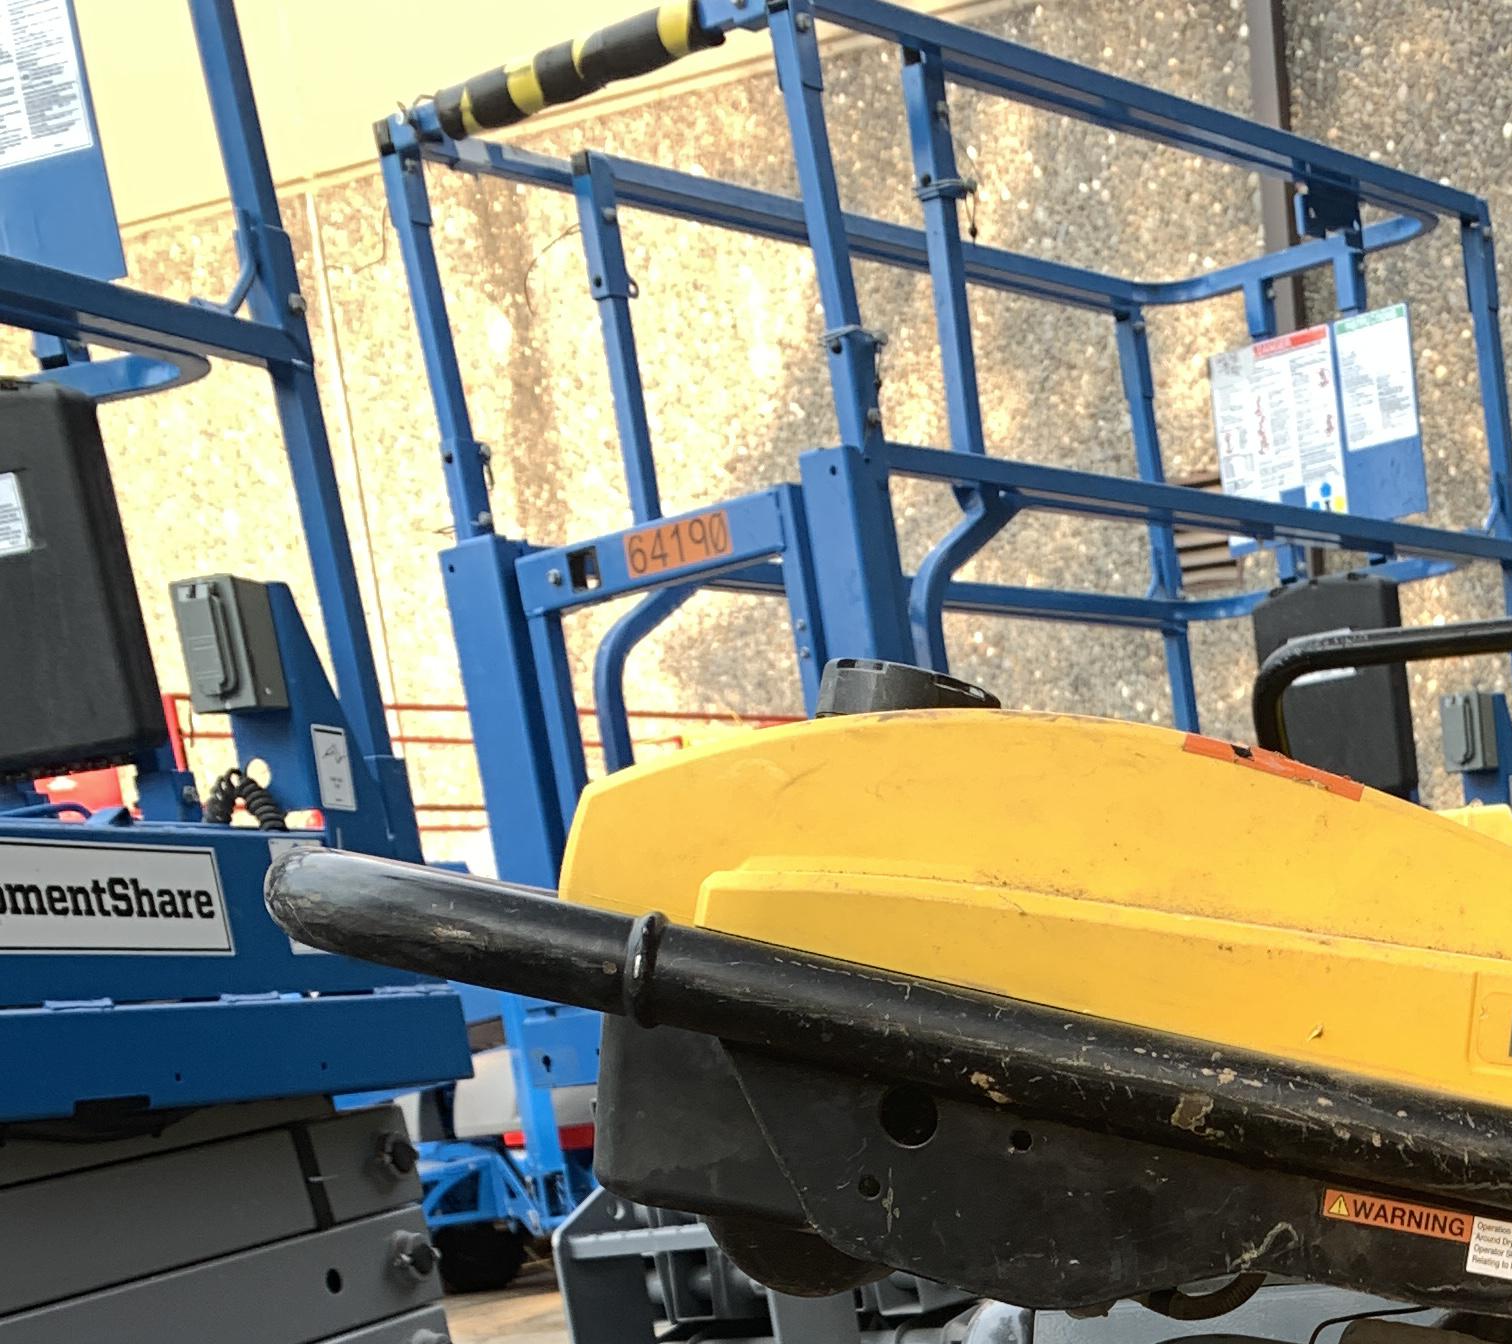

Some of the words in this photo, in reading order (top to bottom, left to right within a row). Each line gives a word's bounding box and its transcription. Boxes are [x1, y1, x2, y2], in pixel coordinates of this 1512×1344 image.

[1353, 1199, 1465, 1237] WARNING
[1476, 1221, 1511, 1235] Operation
[1475, 1233, 1501, 1244] Around
[1473, 1244, 1504, 1257] Operator
[1471, 1255, 1500, 1268] Relating
[1501, 1261, 1509, 1269] to
